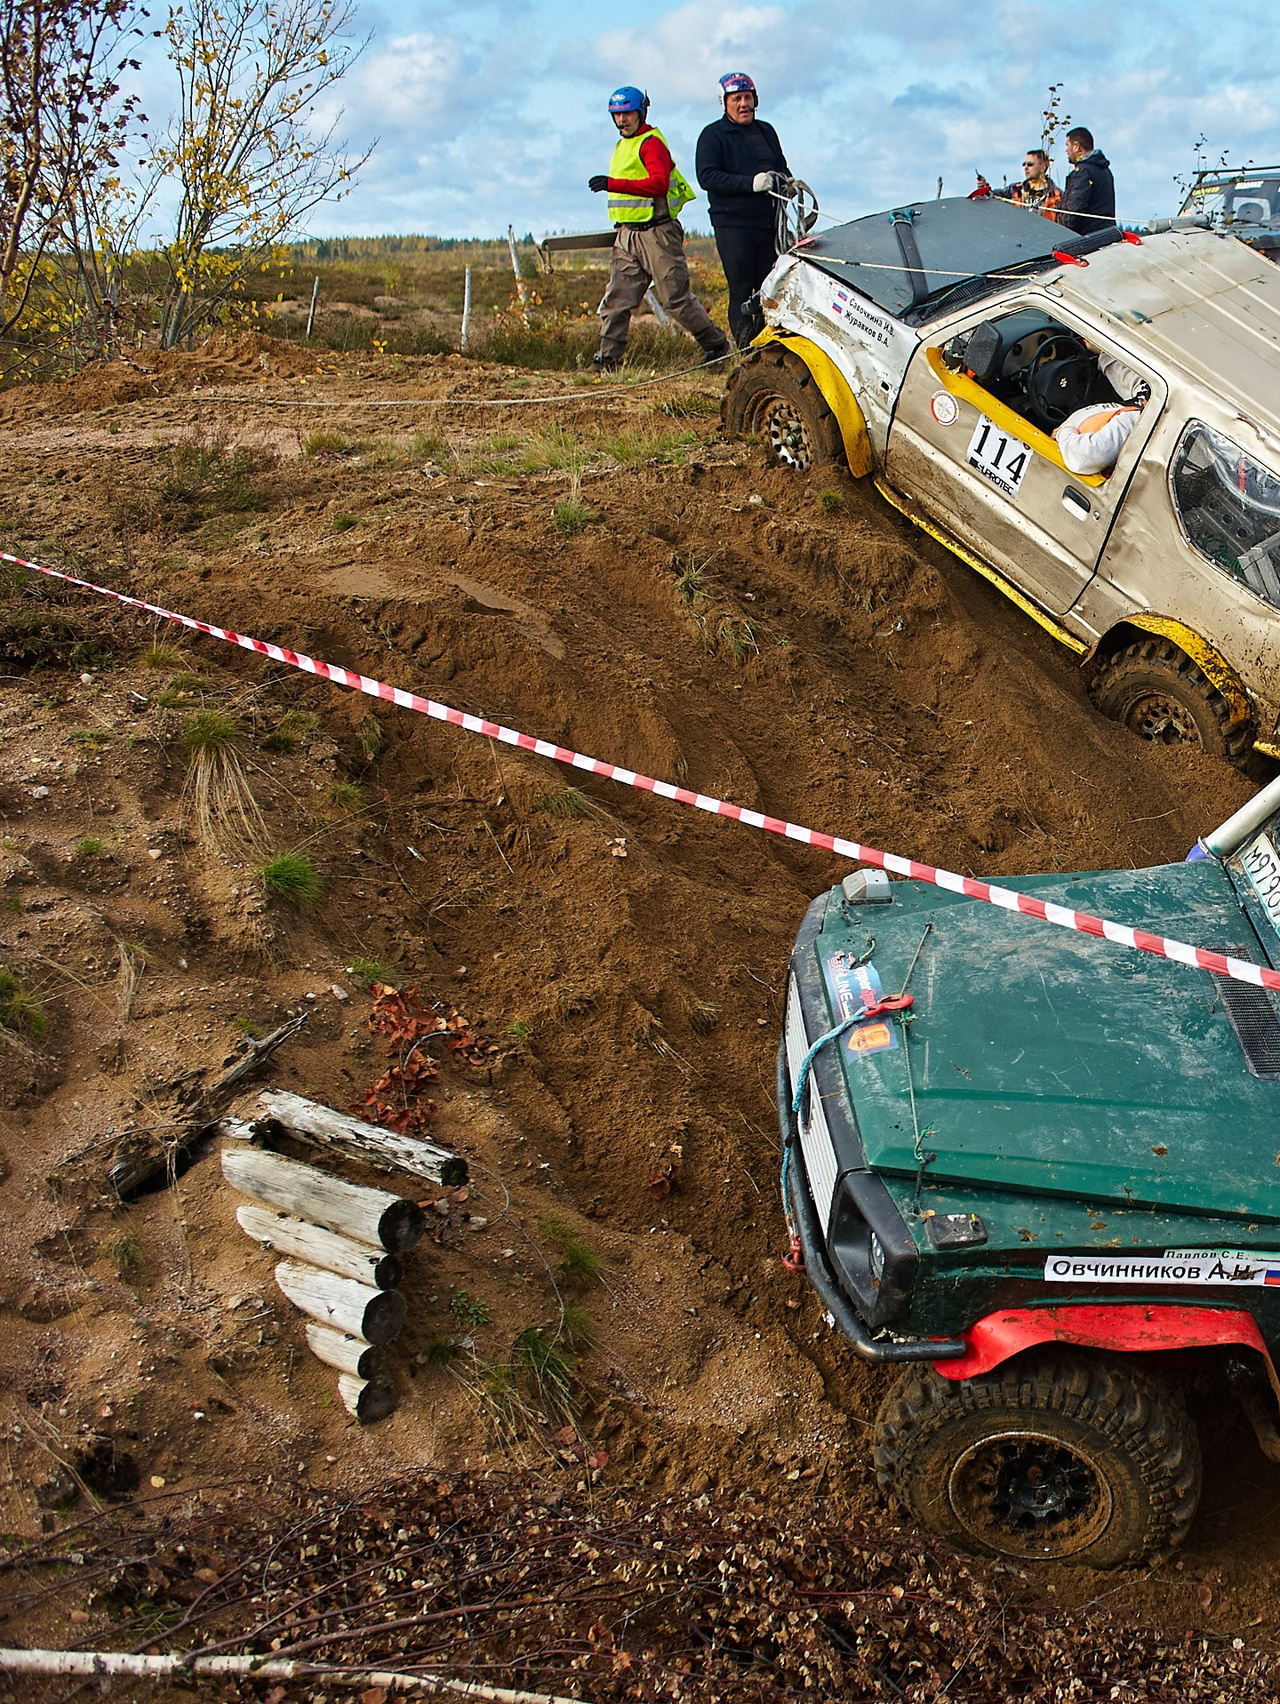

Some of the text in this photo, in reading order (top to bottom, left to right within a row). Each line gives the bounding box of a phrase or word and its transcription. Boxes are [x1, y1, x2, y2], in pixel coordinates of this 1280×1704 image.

[844, 309, 877, 338] Журавков
[849, 298, 883, 329] Савочкина
[974, 424, 1027, 486] 114
[976, 463, 1014, 496] SUPROTEC
[1052, 1260, 1201, 1279] Овчинников
[1166, 1250, 1248, 1260] Павлов С.Е.
